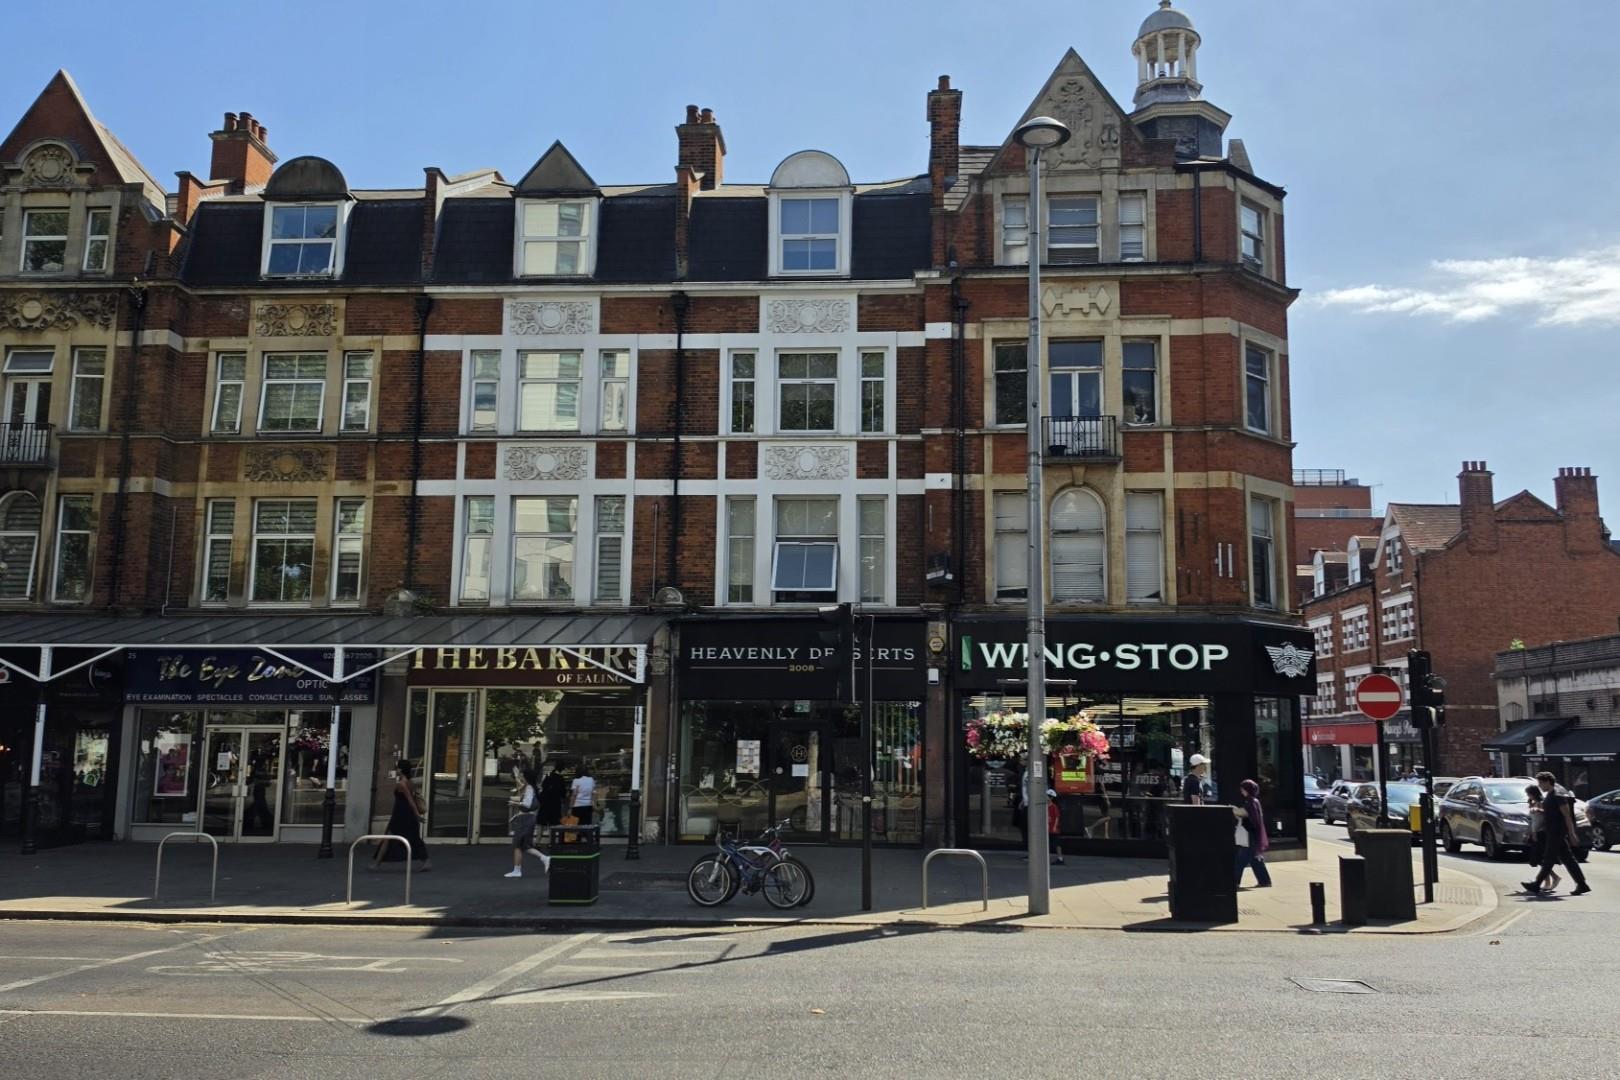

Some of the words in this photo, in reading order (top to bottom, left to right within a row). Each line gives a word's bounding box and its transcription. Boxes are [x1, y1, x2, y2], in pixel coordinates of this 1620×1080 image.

[690, 647, 800, 660] HEAVENLY
[156, 654, 193, 682] The
[198, 655, 241, 689] Eye
[788, 664, 815, 672] 2008
[556, 674, 573, 684] OF
[576, 674, 623, 684] EALING
[126, 693, 141, 701] EYE
[142, 693, 192, 701] EXAMINATION
[196, 693, 243, 701] SPECTACLES
[248, 693, 283, 701] CONTACT
[284, 693, 313, 701] LENSES
